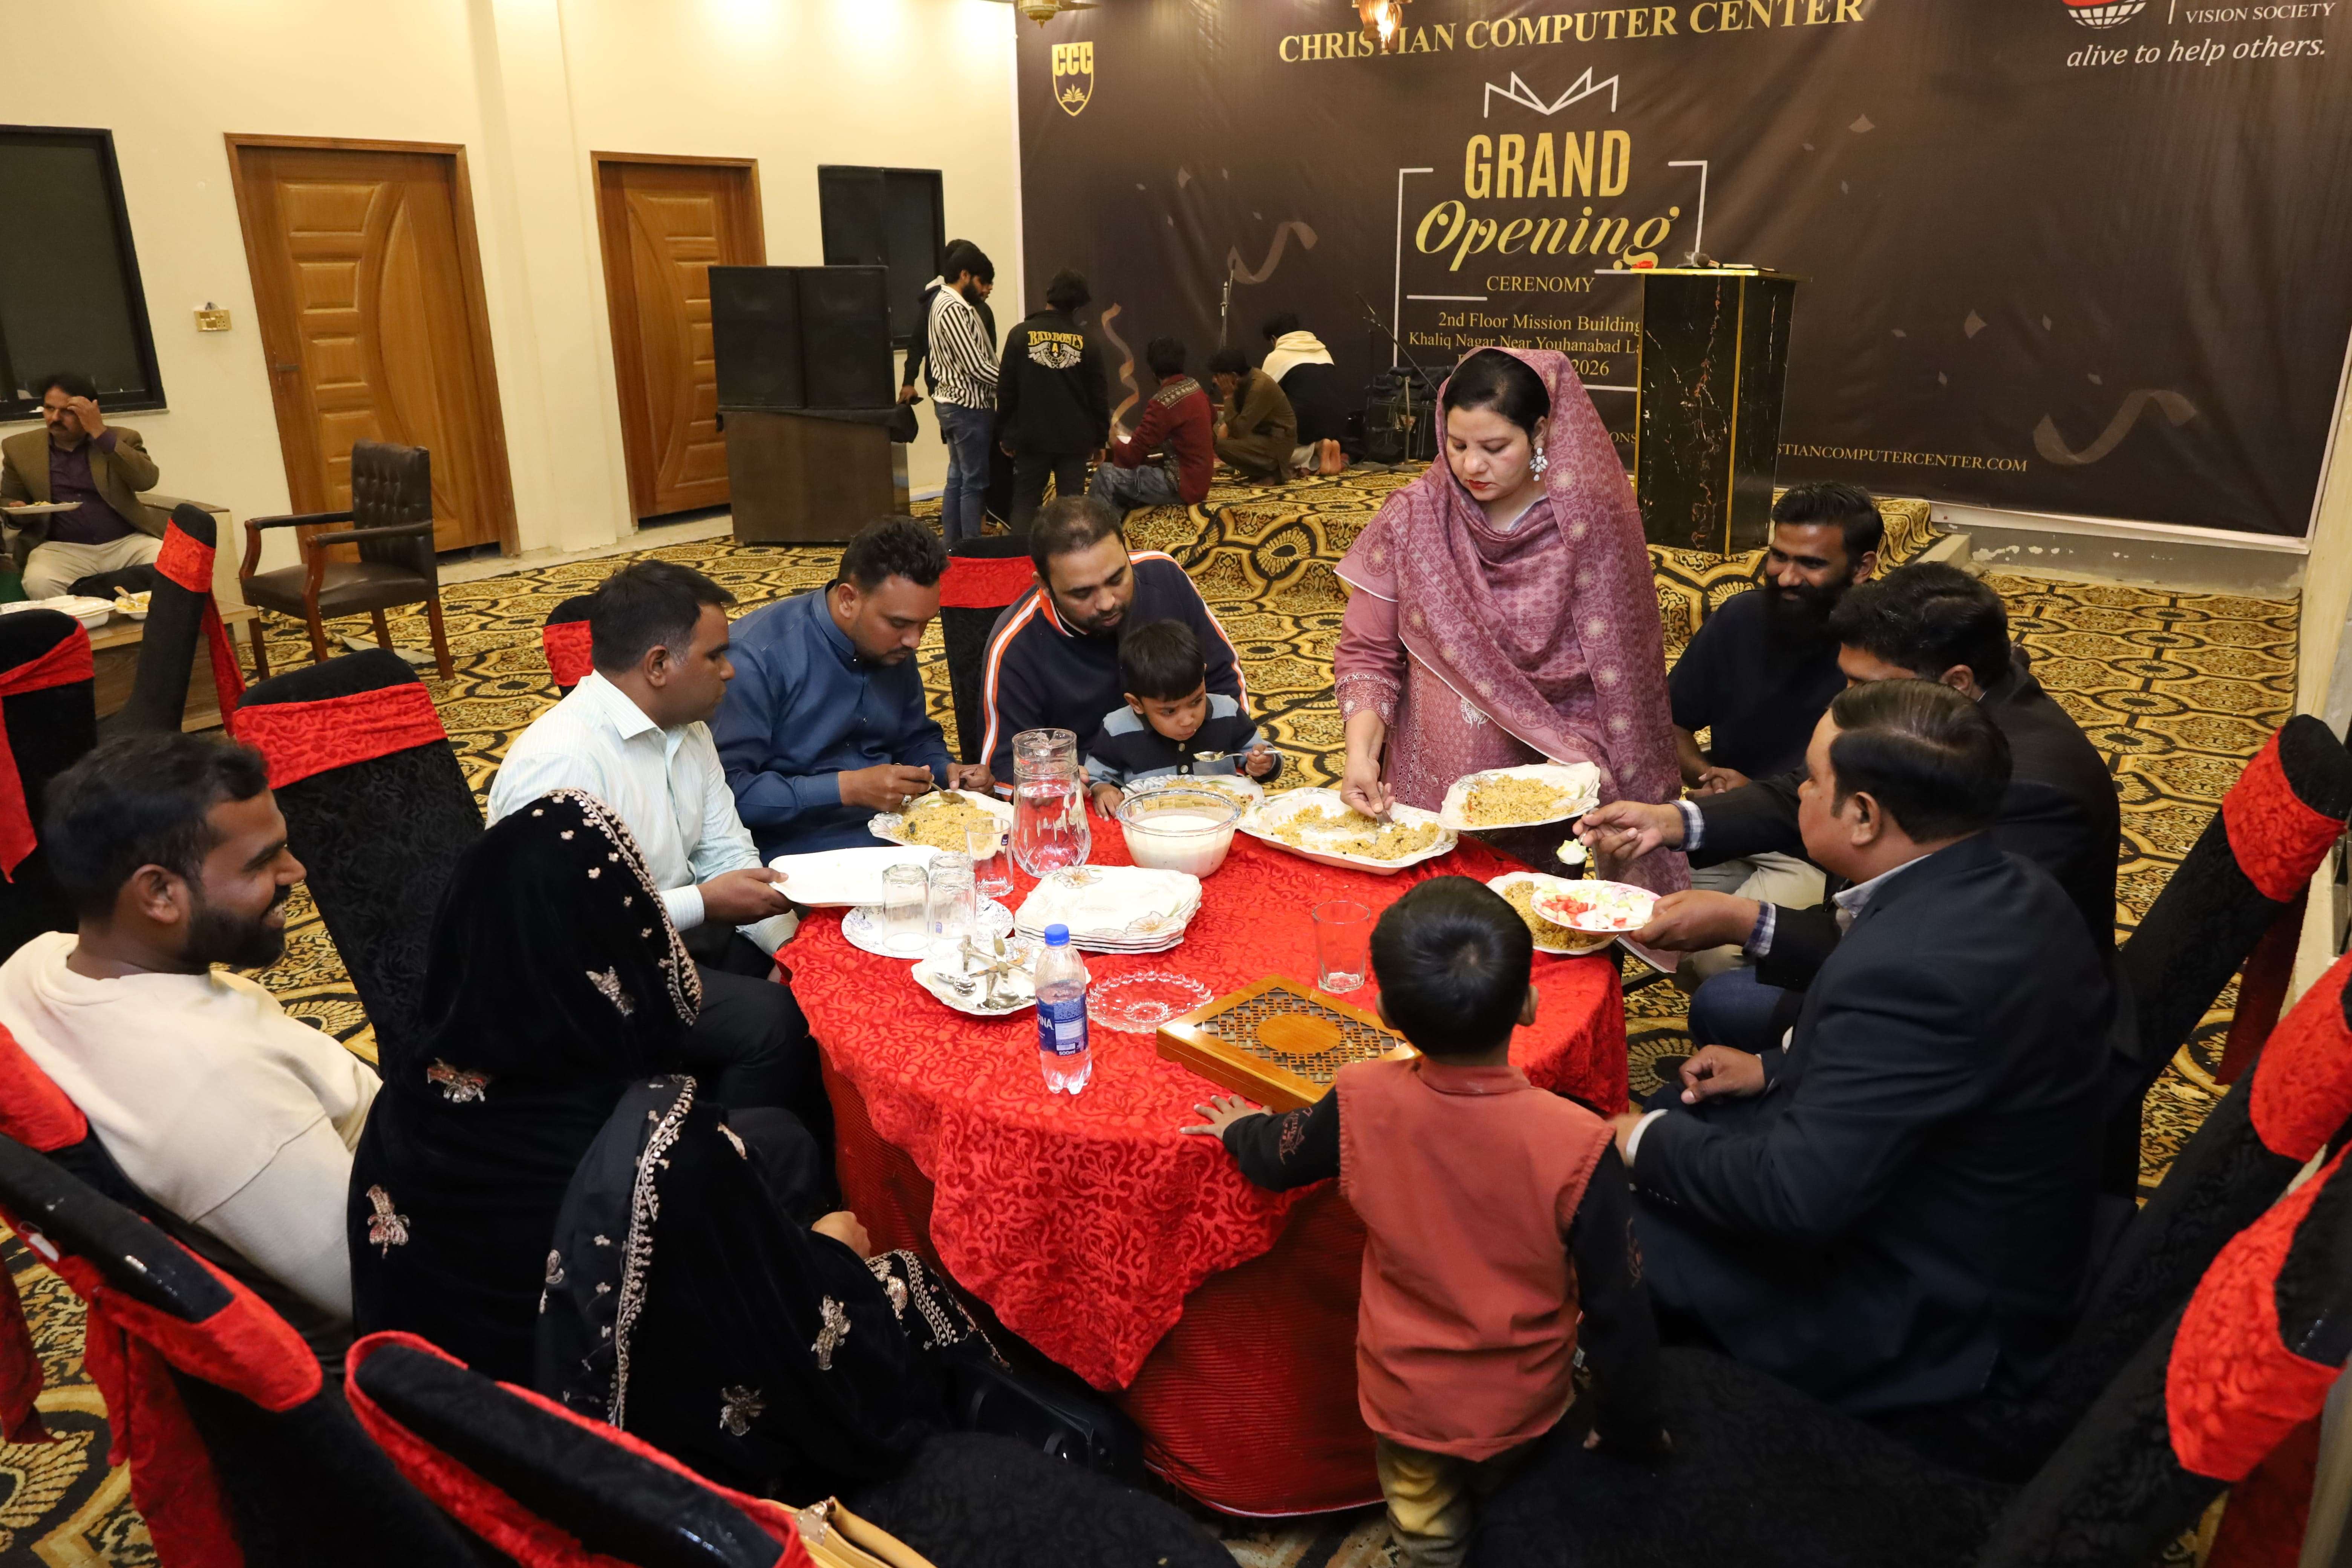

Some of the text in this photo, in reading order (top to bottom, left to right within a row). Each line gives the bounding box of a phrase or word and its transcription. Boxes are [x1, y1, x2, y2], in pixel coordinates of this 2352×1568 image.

[2185, 2, 2337, 24] VISION SOCIETY
[1279, 0, 1864, 62] CHRISIAN COMPUTER CENTER
[1052, 41, 1093, 77] CCC
[2067, 35, 2326, 67] alive to help others.
[1465, 130, 1631, 199] GRAND
[1415, 200, 1680, 272] Opening
[1486, 276, 1596, 292] CERENOMY
[1438, 312, 1640, 337] 2nd Floor Mission Building
[1027, 331, 1052, 346] BAD
[1409, 332, 1451, 349] Khaliq
[1456, 334, 1496, 347] Nagar
[1499, 335, 1532, 349] Near
[1536, 336, 1620, 353] Youhanabad
[1571, 359, 1609, 376] 2026
